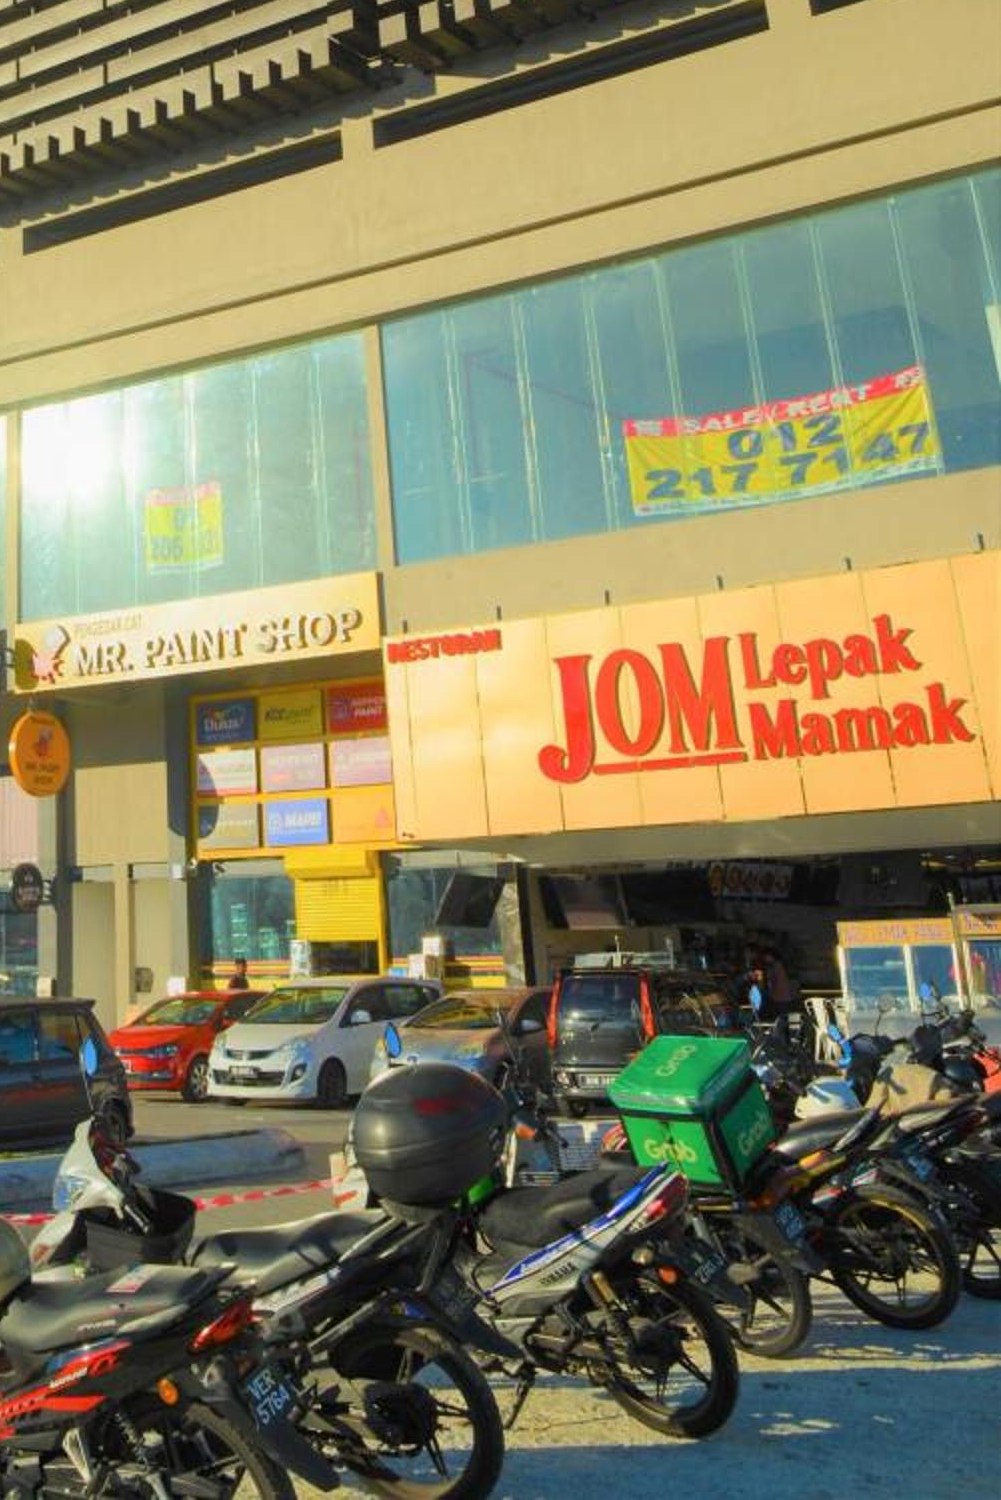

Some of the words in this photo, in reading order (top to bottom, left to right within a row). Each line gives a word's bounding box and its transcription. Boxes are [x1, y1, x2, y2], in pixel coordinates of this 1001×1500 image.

[727, 413, 843, 460] 012
[645, 462, 759, 500] 217
[71, 638, 134, 677] MR.
[146, 622, 248, 669] PAINT
[258, 608, 363, 654] SHOP
[737, 613, 923, 700] Lepak
[537, 634, 746, 785] JOM
[749, 682, 978, 762] Mamak
